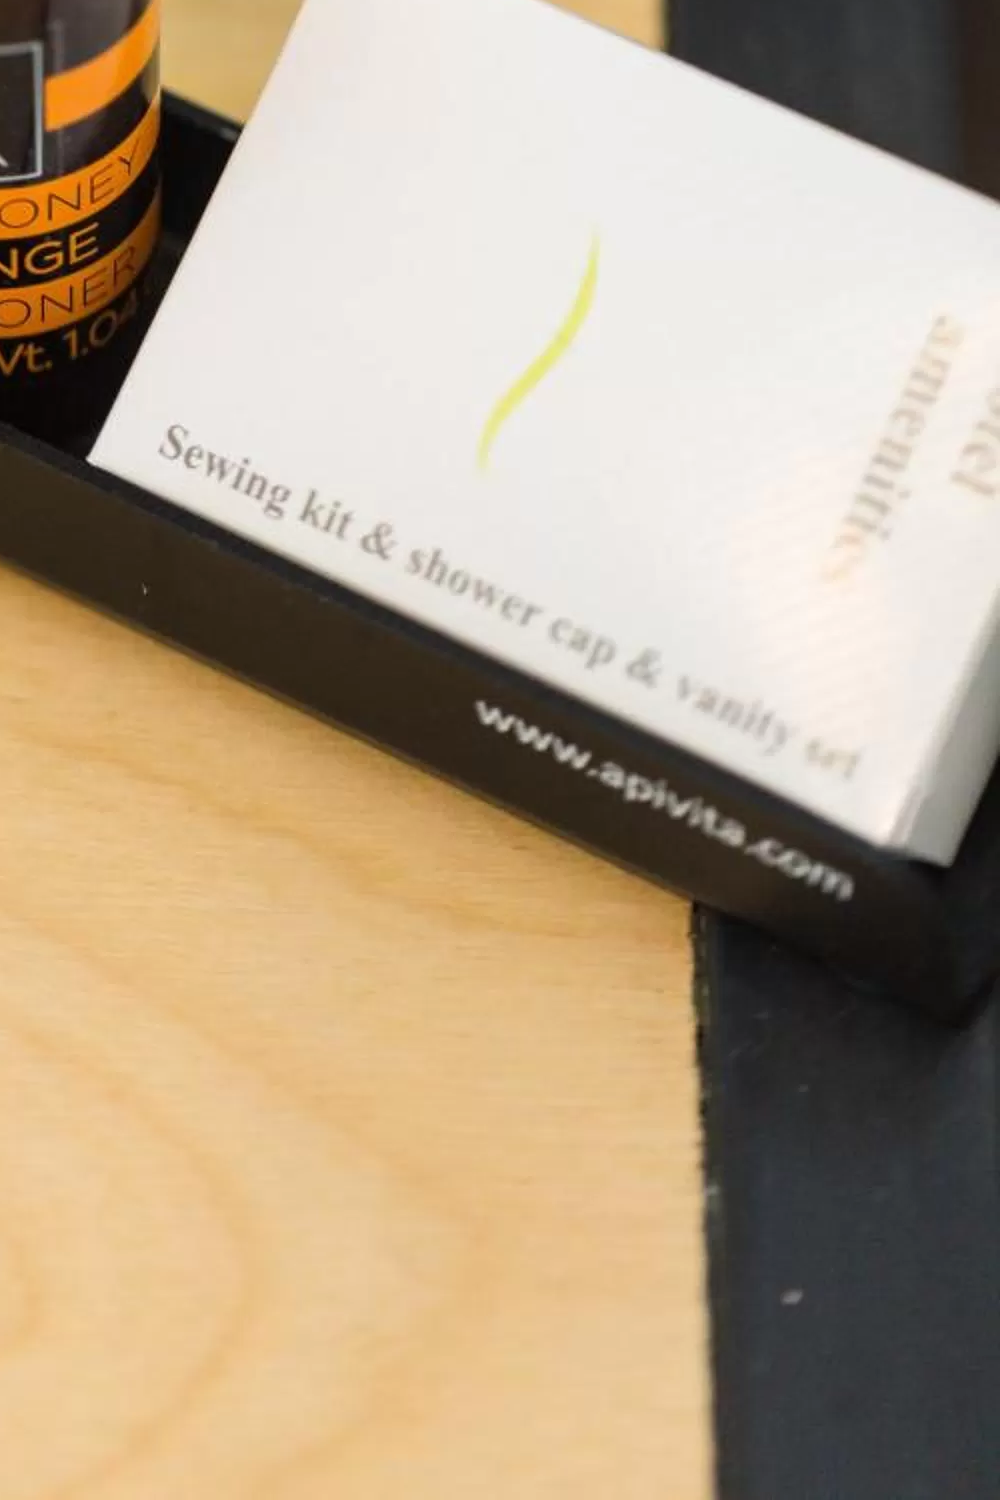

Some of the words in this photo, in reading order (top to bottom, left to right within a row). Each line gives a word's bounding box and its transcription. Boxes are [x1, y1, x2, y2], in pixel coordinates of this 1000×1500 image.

[157, 423, 292, 520] Sewing
[299, 488, 355, 541] kit
[360, 520, 400, 562] &
[404, 546, 543, 627] shower
[548, 616, 618, 670] cap
[625, 647, 663, 689] &
[677, 674, 797, 754] vanity
[473, 699, 855, 900] www.apivita.com
